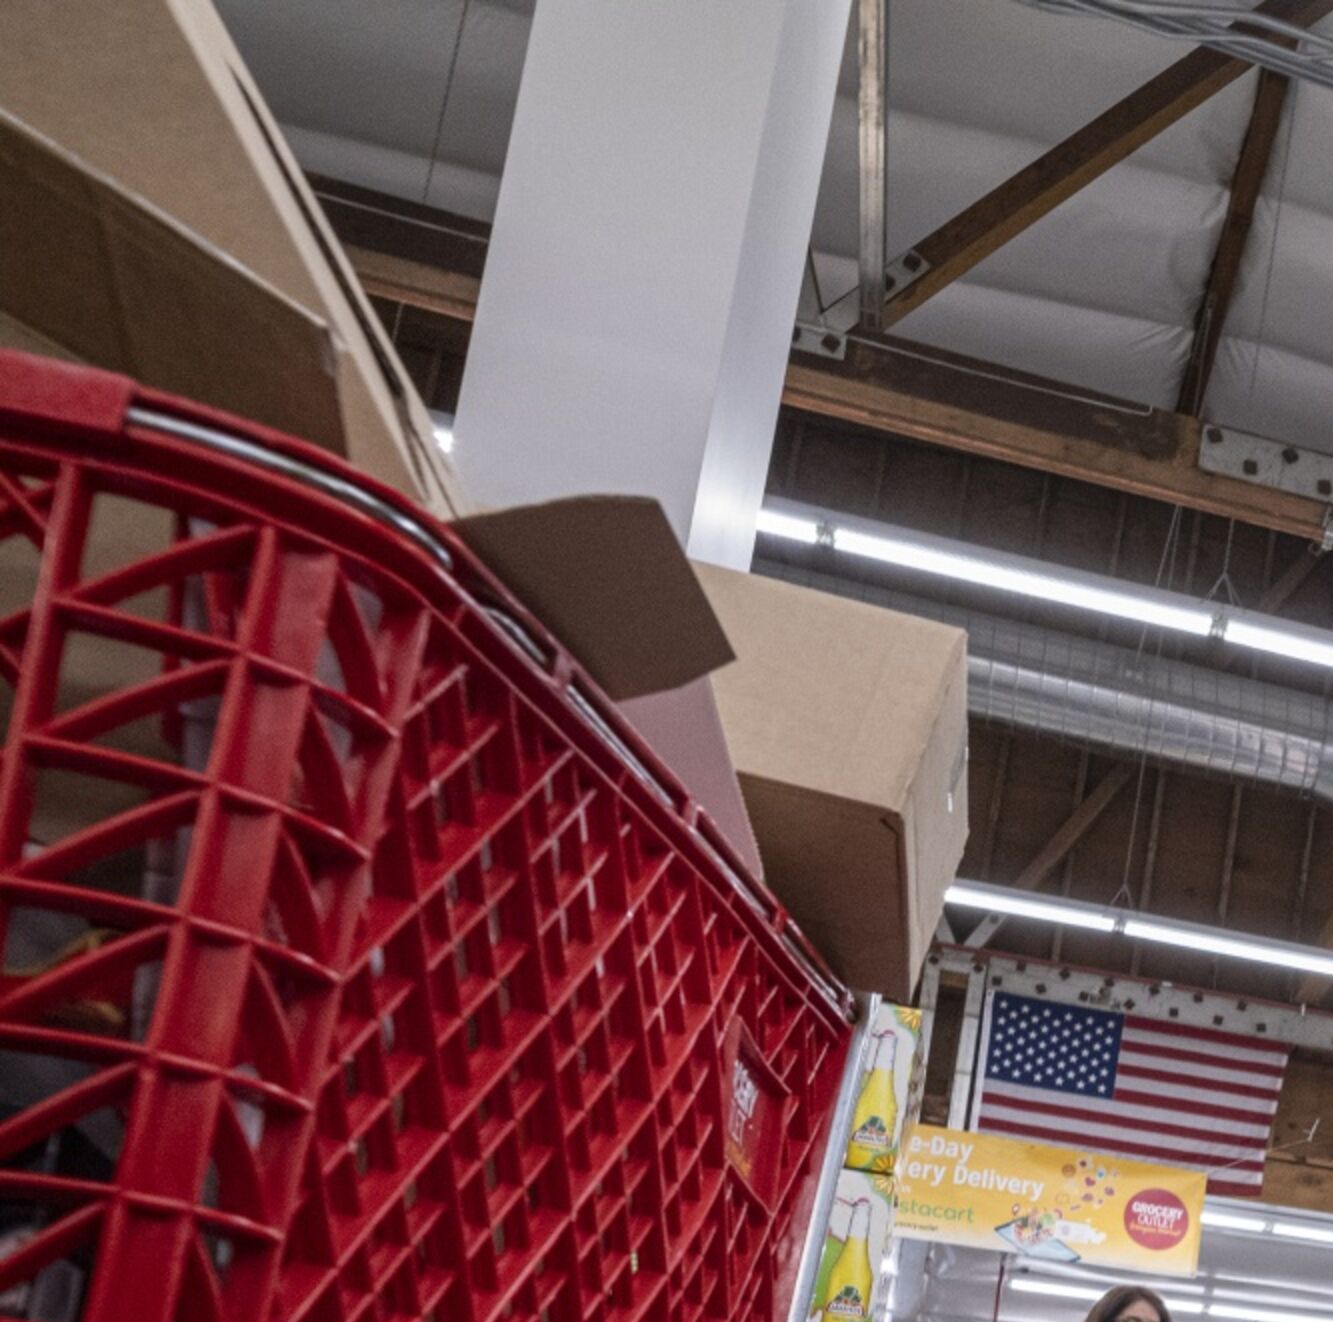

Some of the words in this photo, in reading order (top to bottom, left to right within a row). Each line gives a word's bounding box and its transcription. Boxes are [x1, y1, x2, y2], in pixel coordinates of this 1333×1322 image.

[908, 1135, 975, 1165] e-Day
[952, 1168, 1046, 1201] Delivery
[899, 1198, 975, 1223] stacart
